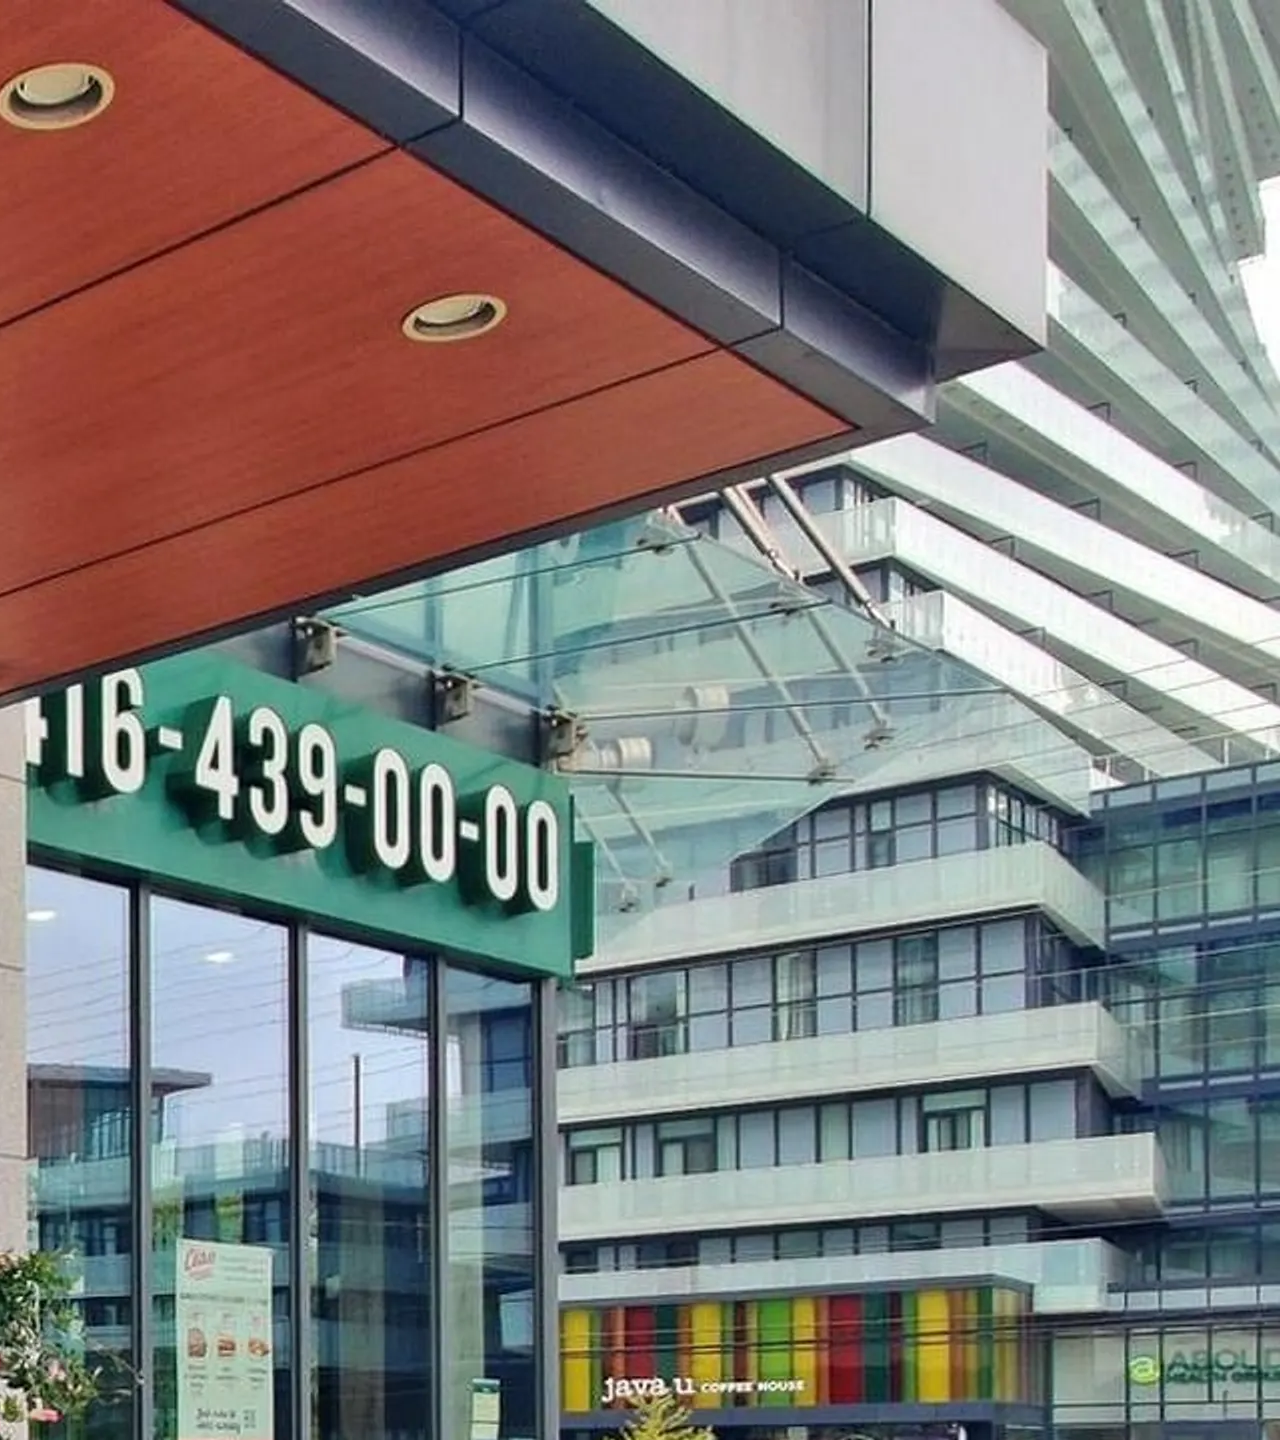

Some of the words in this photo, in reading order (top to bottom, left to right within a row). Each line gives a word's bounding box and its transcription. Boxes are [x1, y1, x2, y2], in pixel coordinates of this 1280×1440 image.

[602, 1377, 670, 1402] java
[674, 1378, 696, 1395] u
[701, 1381, 754, 1393] COFFEE
[757, 1379, 805, 1392] HOUSE
